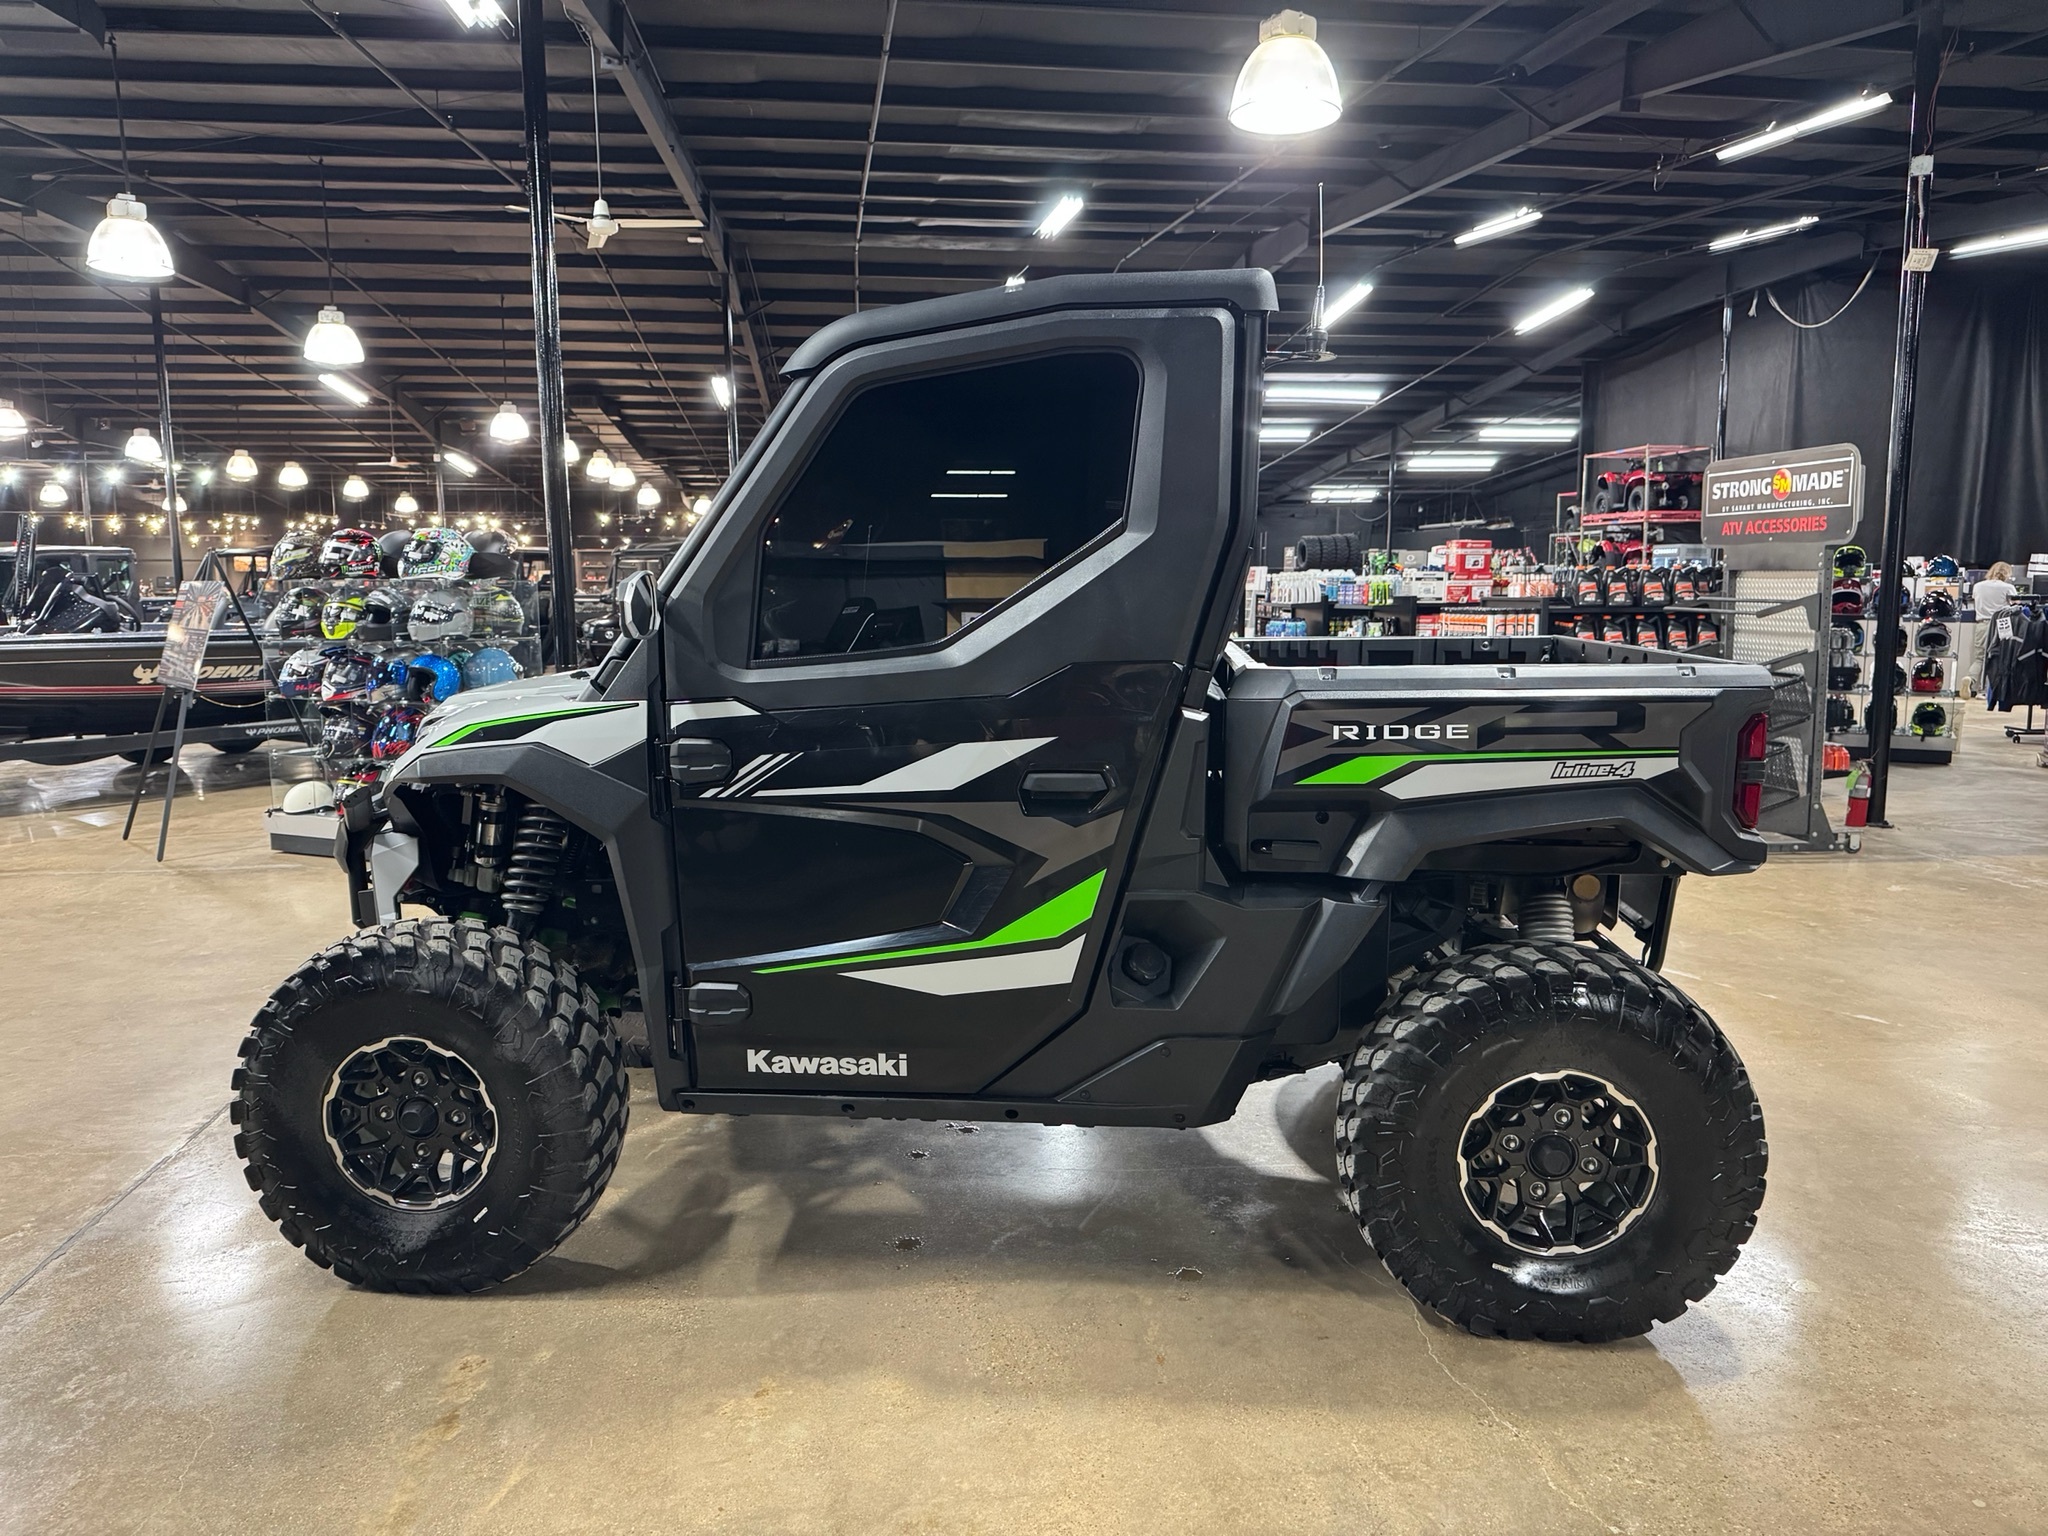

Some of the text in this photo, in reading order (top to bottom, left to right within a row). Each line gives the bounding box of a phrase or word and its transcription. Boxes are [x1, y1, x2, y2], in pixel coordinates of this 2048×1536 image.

[1712, 477, 1772, 500] STRONG
[1792, 470, 1844, 492] MADE
[1818, 497, 1834, 505] INC.
[1722, 515, 1827, 536] ATV ACCESSORIES
[197, 664, 264, 679] OENIX
[1333, 724, 1469, 740] RIDGE
[1550, 761, 1636, 778] Inline-4
[747, 1049, 908, 1077] Kawasaki
